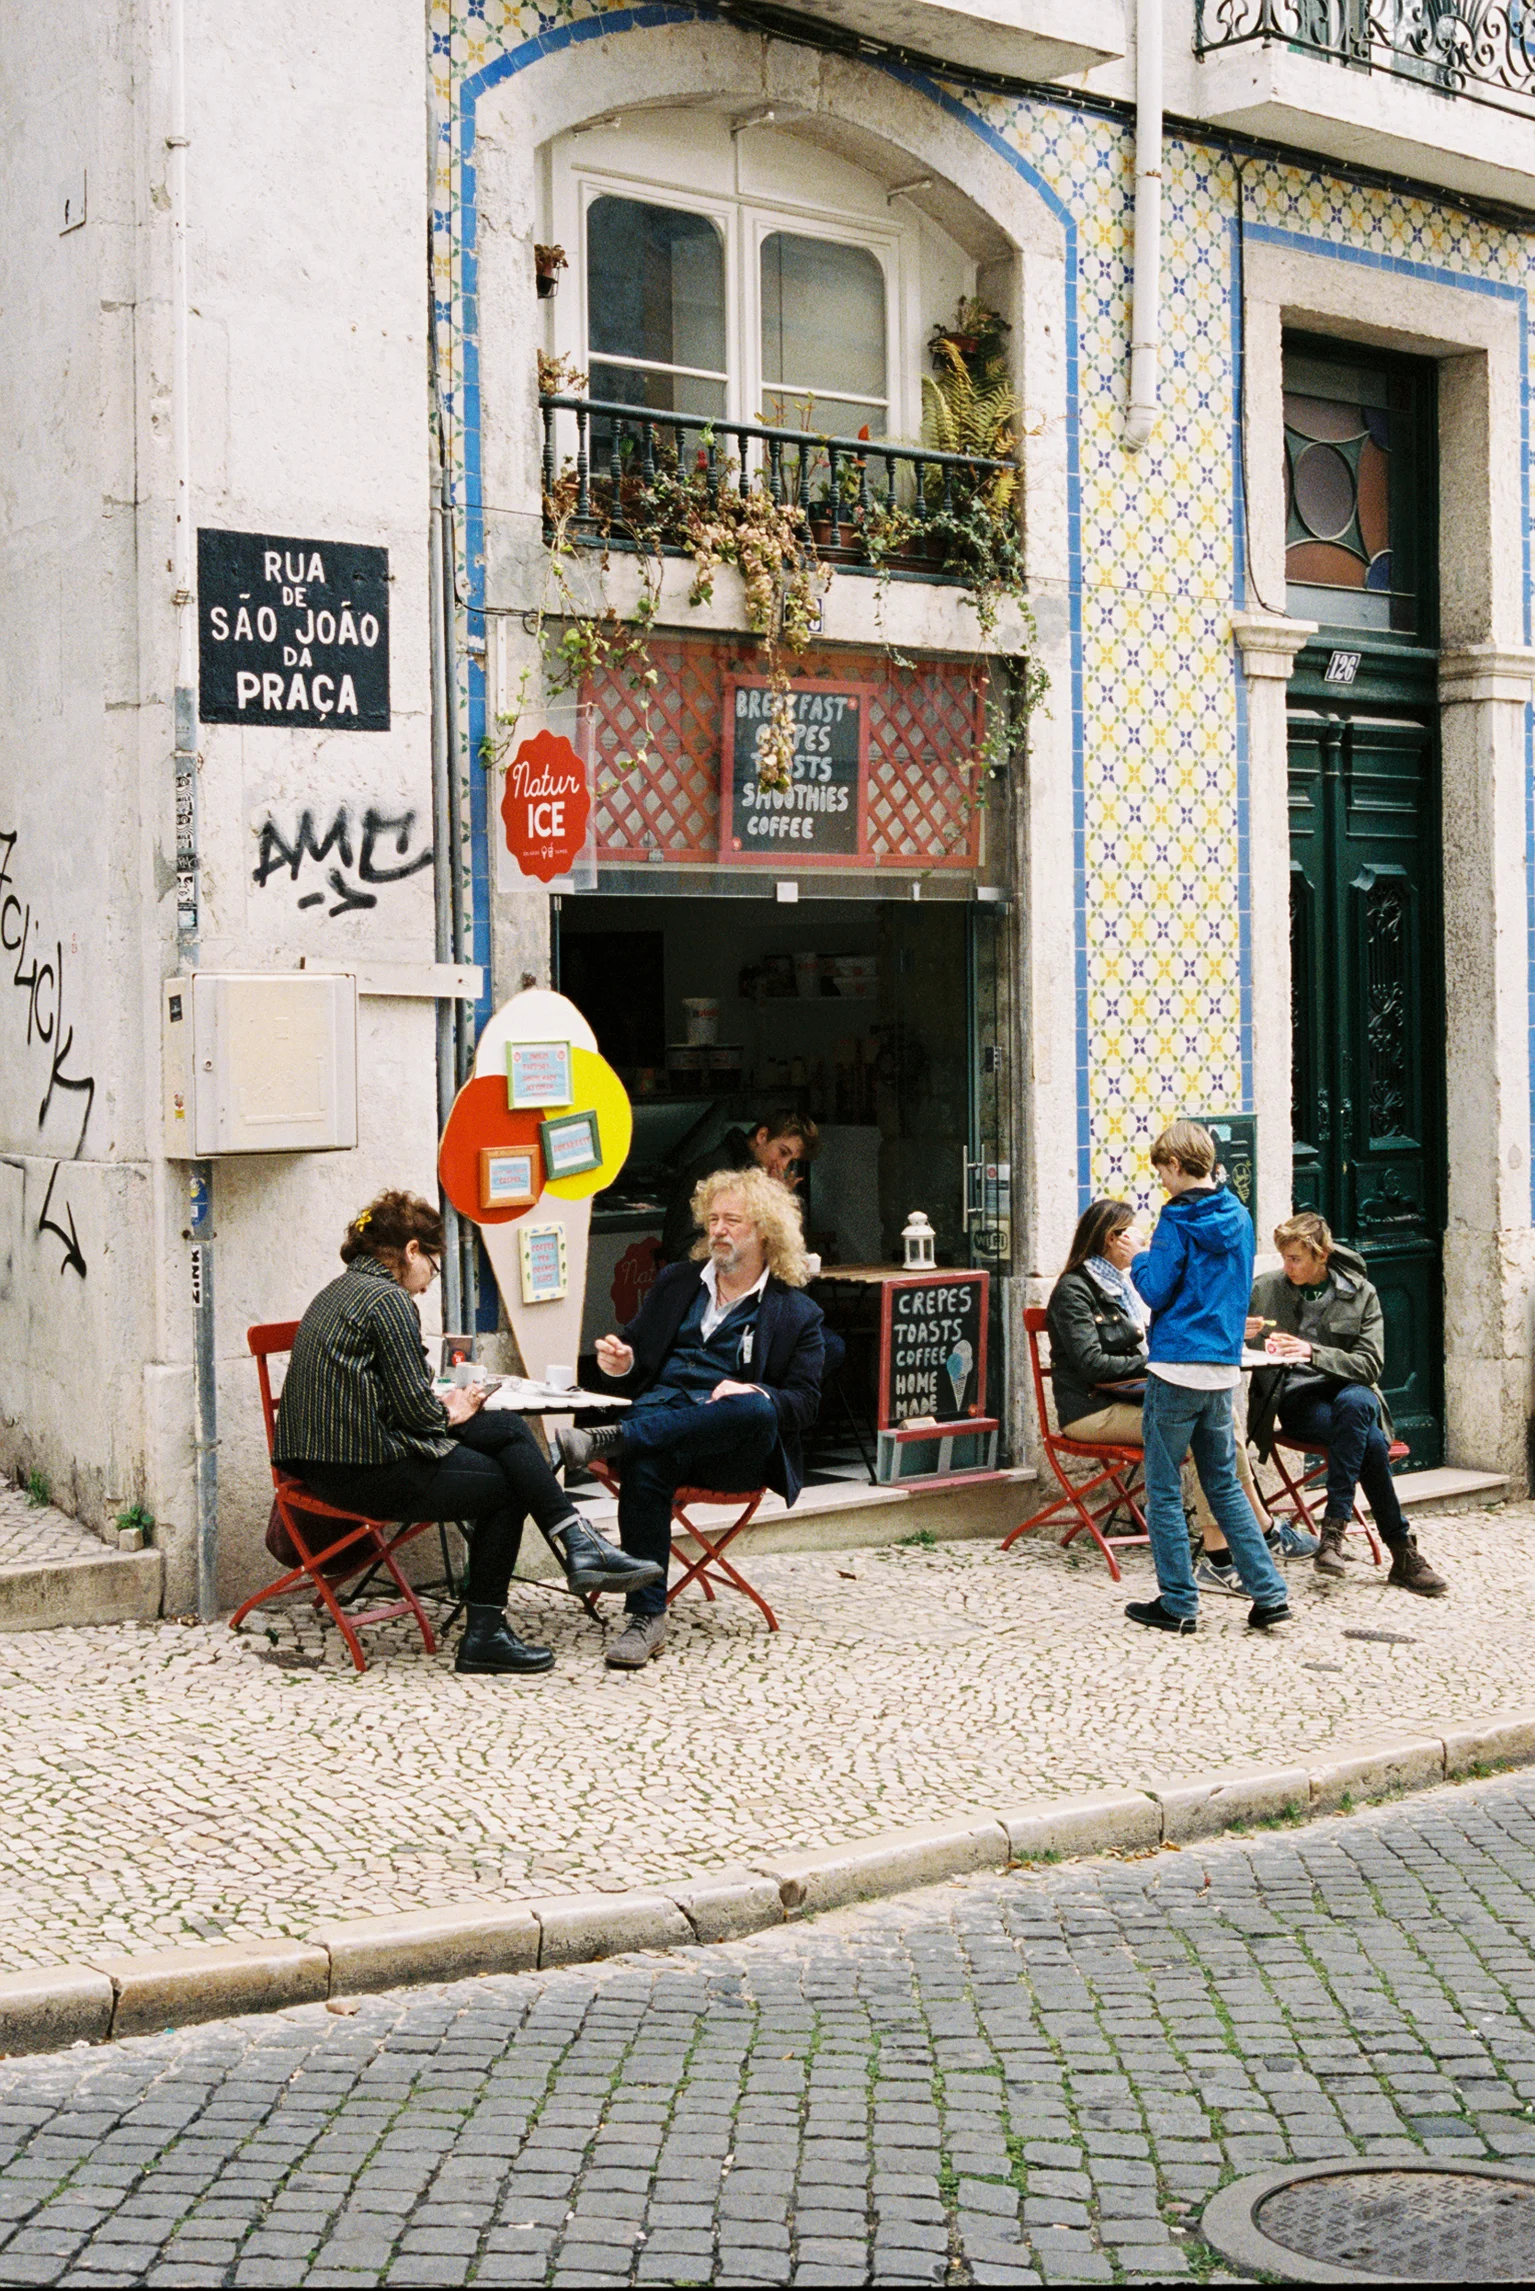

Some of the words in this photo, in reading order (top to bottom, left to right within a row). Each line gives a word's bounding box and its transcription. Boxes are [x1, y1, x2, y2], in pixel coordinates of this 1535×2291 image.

[264, 551, 325, 583] RUA
[282, 586, 307, 607] DE
[210, 593, 277, 642] SÃO
[295, 601, 379, 647] JOÃO
[283, 646, 312, 667] DA
[1328, 654, 1357, 680] 126
[237, 671, 358, 721] PRAÇA
[512, 760, 579, 798] Natur
[528, 801, 565, 839] ICE
[747, 816, 814, 839] COFFEE
[898, 1286, 971, 1315] CREPES
[893, 1318, 963, 1344] TOASTS
[896, 1346, 947, 1367] COFFEE
[895, 1371, 938, 1395] HOME
[895, 1394, 938, 1419] MADE
